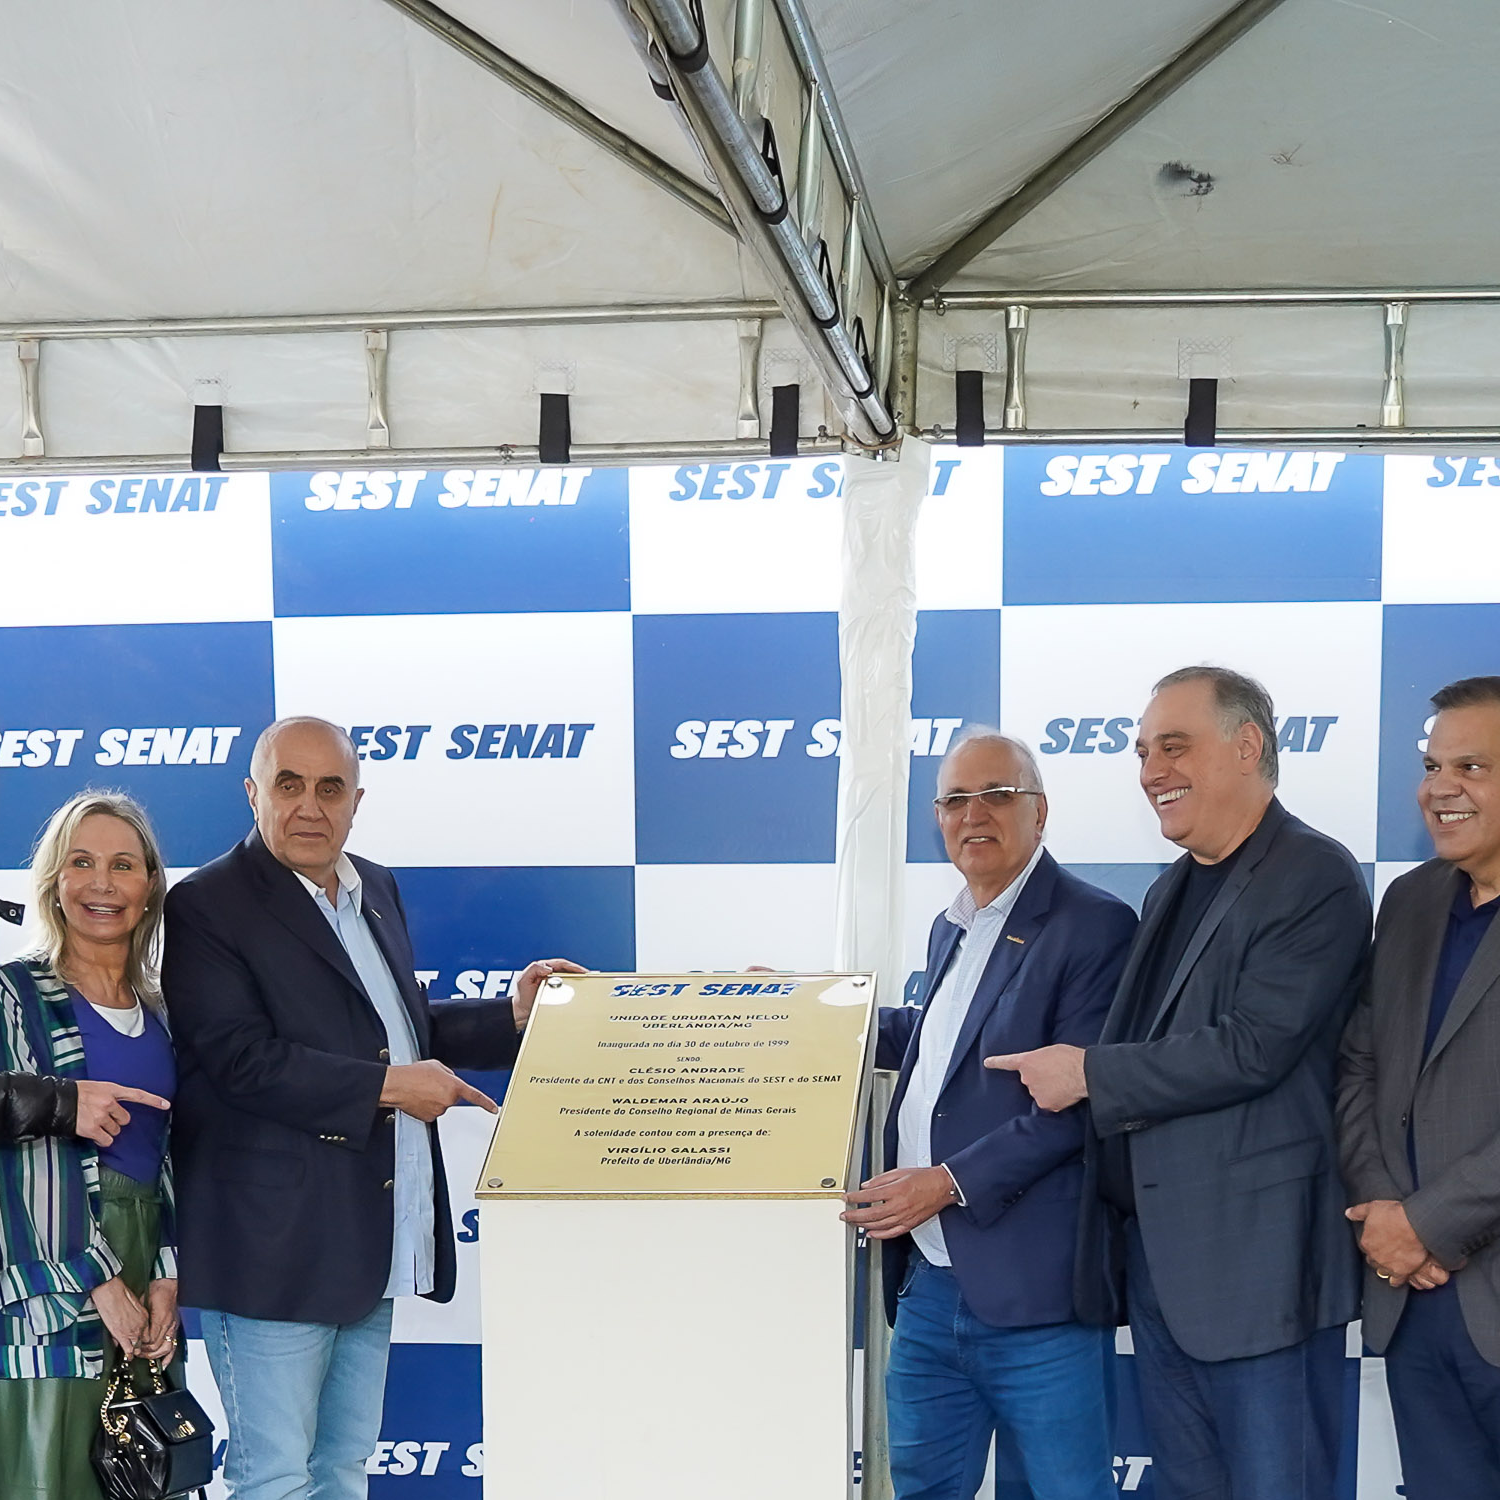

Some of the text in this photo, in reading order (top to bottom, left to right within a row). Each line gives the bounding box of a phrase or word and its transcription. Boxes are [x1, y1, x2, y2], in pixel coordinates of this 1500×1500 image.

[668, 463, 792, 502] SEST
[1040, 451, 1346, 497] SEST SENAT
[85, 476, 230, 515] SENAT
[304, 466, 593, 512] SEST SENAT
[95, 726, 242, 767] SENAT
[340, 723, 595, 761] EST SENAT
[669, 719, 795, 760] SEST
[1039, 716, 1142, 755] SES
[610, 982, 801, 998] SEST SENAT
[609, 1013, 790, 1022] UNIDADE URUBATAN HELOU
[597, 1040, 650, 1049] Inaugurada
[667, 1040, 681, 1048] dia
[684, 1040, 697, 1048] 30
[699, 1040, 711, 1048] de
[713, 1040, 751, 1048] outubro
[753, 1040, 765, 1048] de
[767, 1039, 790, 1047] 1999
[529, 1076, 580, 1085] Presidente
[583, 1077, 595, 1085] da
[597, 1077, 616, 1085] CNT
[627, 1077, 644, 1085] dos
[647, 1076, 695, 1085] Conselhos
[698, 1076, 745, 1085] Nacionais
[748, 1076, 760, 1084] do
[762, 1076, 786, 1084] SEST
[797, 1075, 809, 1084] do
[811, 1075, 842, 1084] SENAT
[629, 1066, 746, 1074] CLÉSIO ANDRADE
[559, 1106, 797, 1117] Presidente do Conselho Regional de Minas Gerais
[574, 1129, 581, 1137] A
[584, 1129, 636, 1137] solenidade
[708, 1130, 753, 1138] presença
[600, 1156, 732, 1166] Prefeito de Uberlândia/MG
[607, 1146, 731, 1154] VIRGÍLIO GALASSI
[366, 1440, 450, 1477] EST
